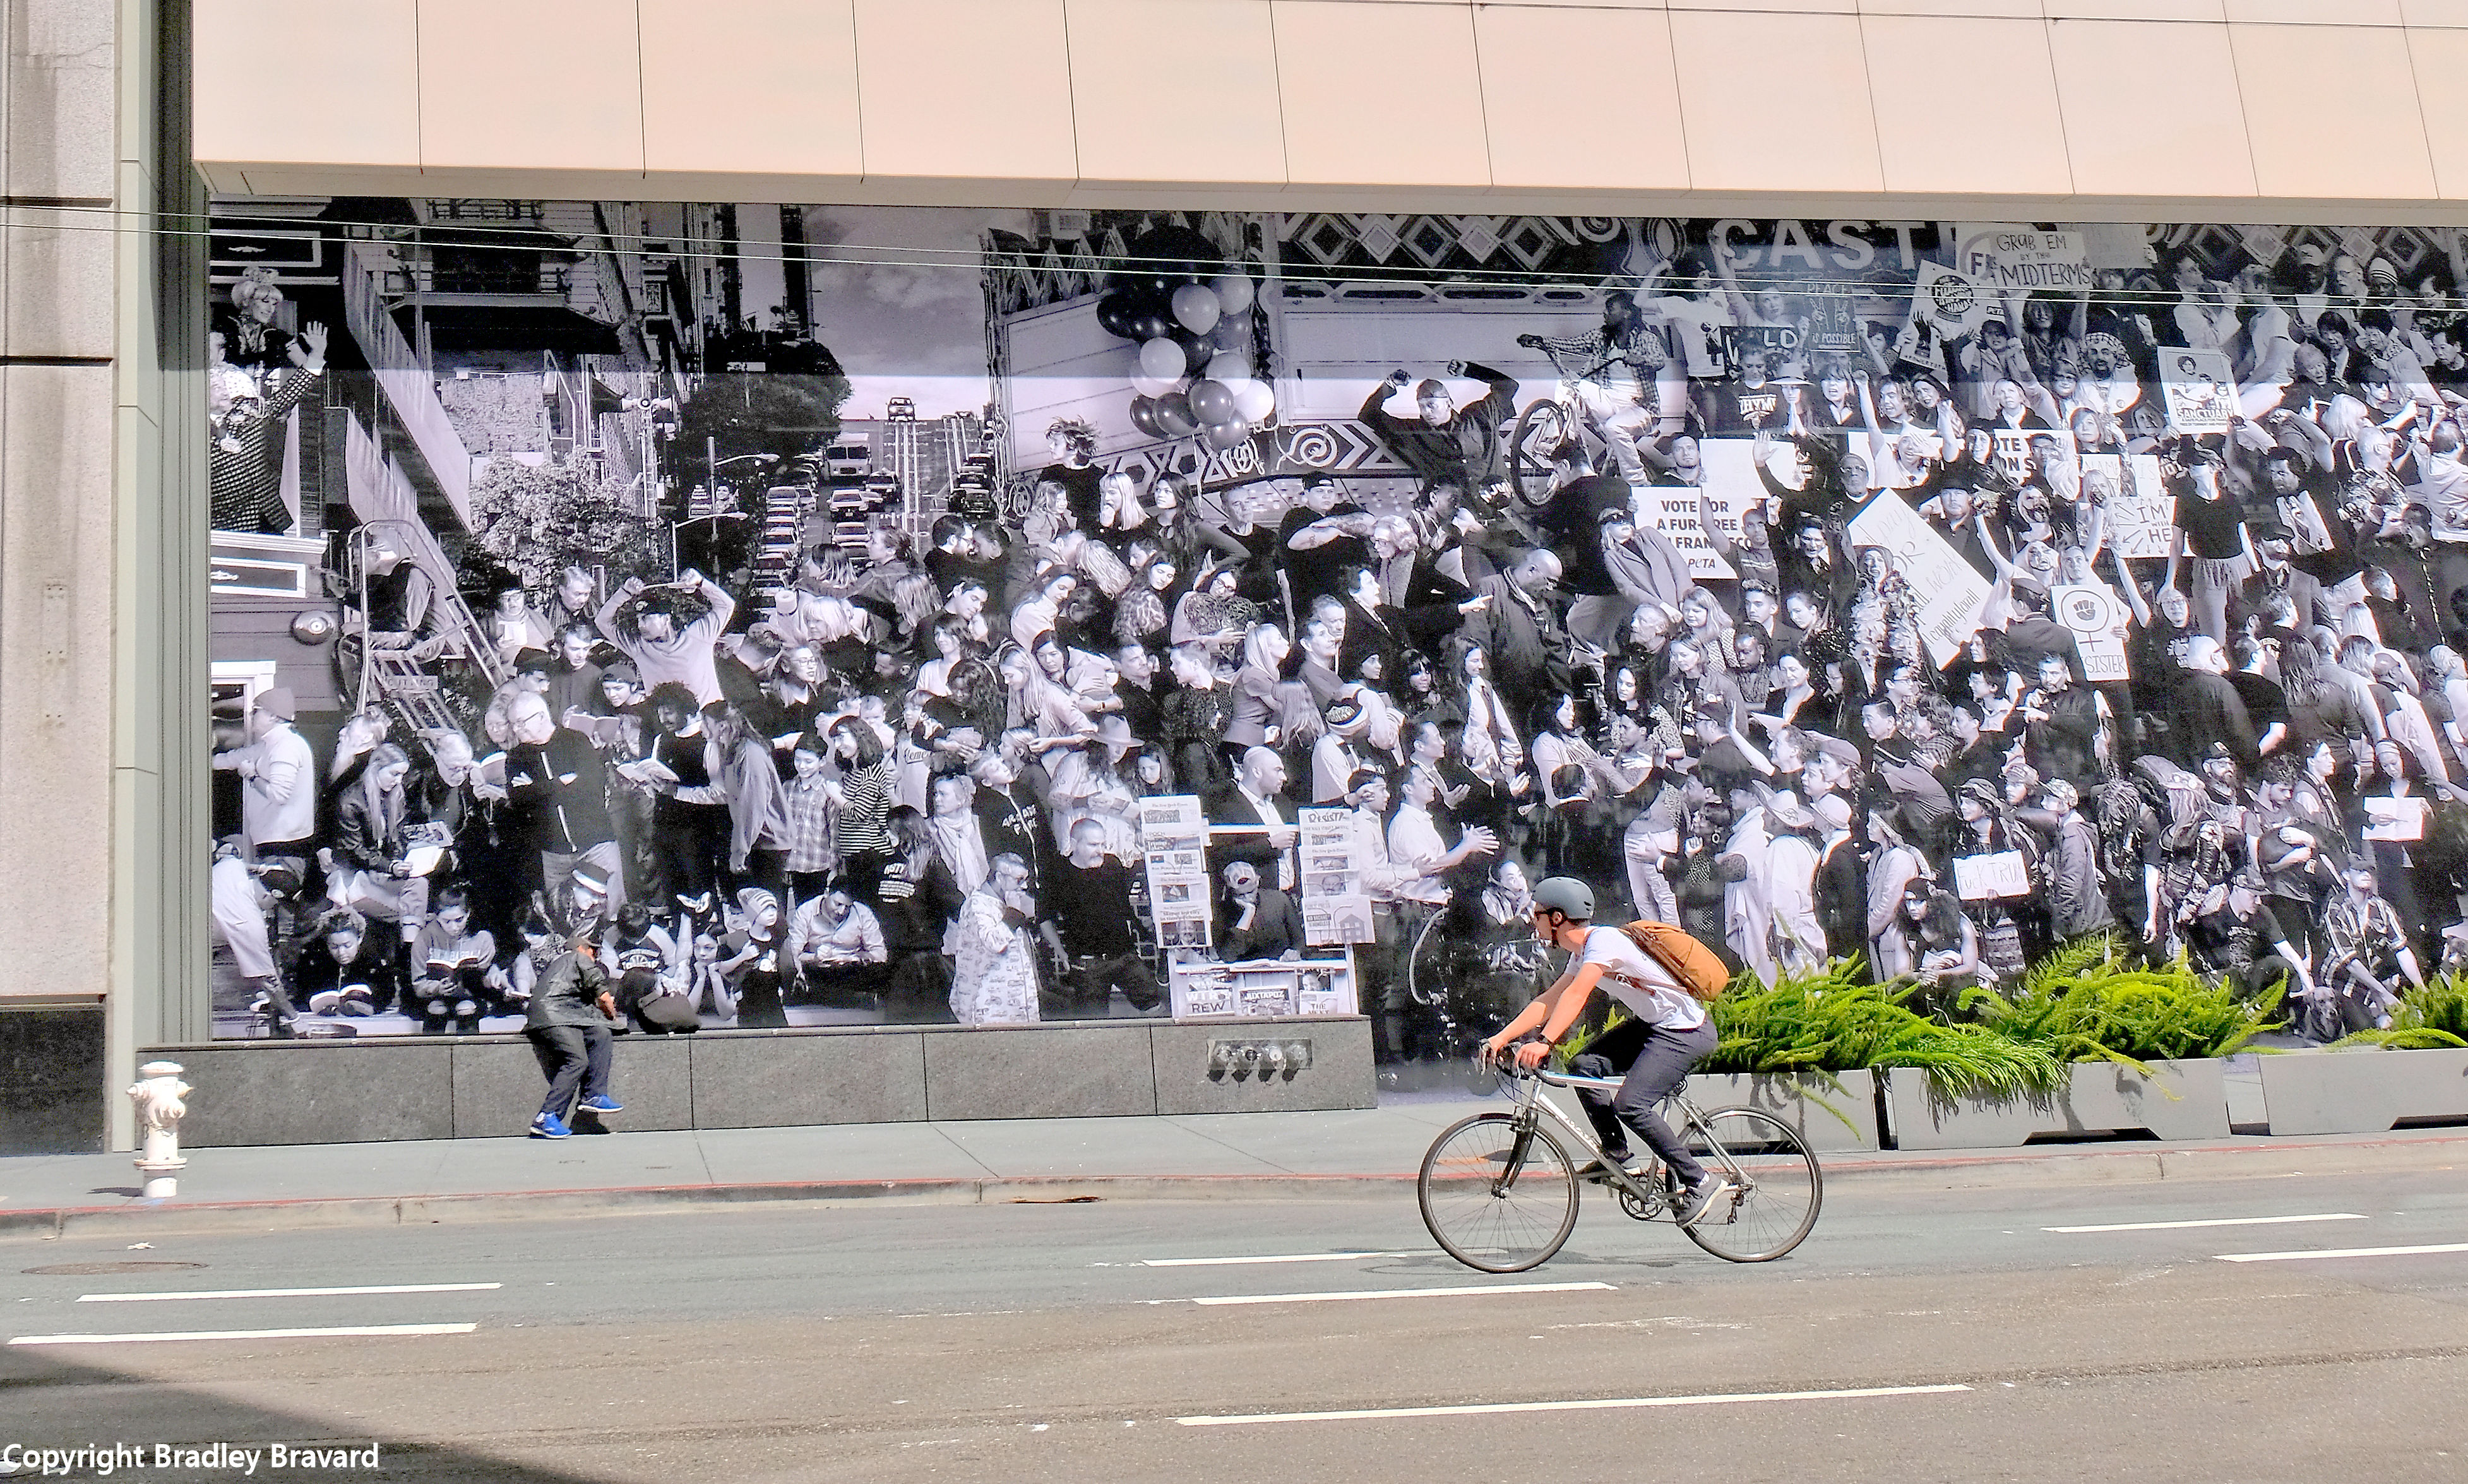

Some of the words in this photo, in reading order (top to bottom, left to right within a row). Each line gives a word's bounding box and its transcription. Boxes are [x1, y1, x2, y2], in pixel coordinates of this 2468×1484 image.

[2000, 263, 2090, 287] MIDTERMS
[1821, 333, 1856, 344] POSSIBLE
[2177, 409, 2233, 418] SANCTUARY
[1993, 437, 2022, 451] OTE
[1660, 500, 1697, 513] VOTE
[1709, 501, 1729, 513] OR
[1657, 518, 1667, 530] A
[1669, 518, 1738, 530] FUR-REE
[2147, 528, 2173, 543] HE
[2085, 654, 2126, 674] SISTER
[1244, 991, 1285, 1000] JUXTAPOZ
